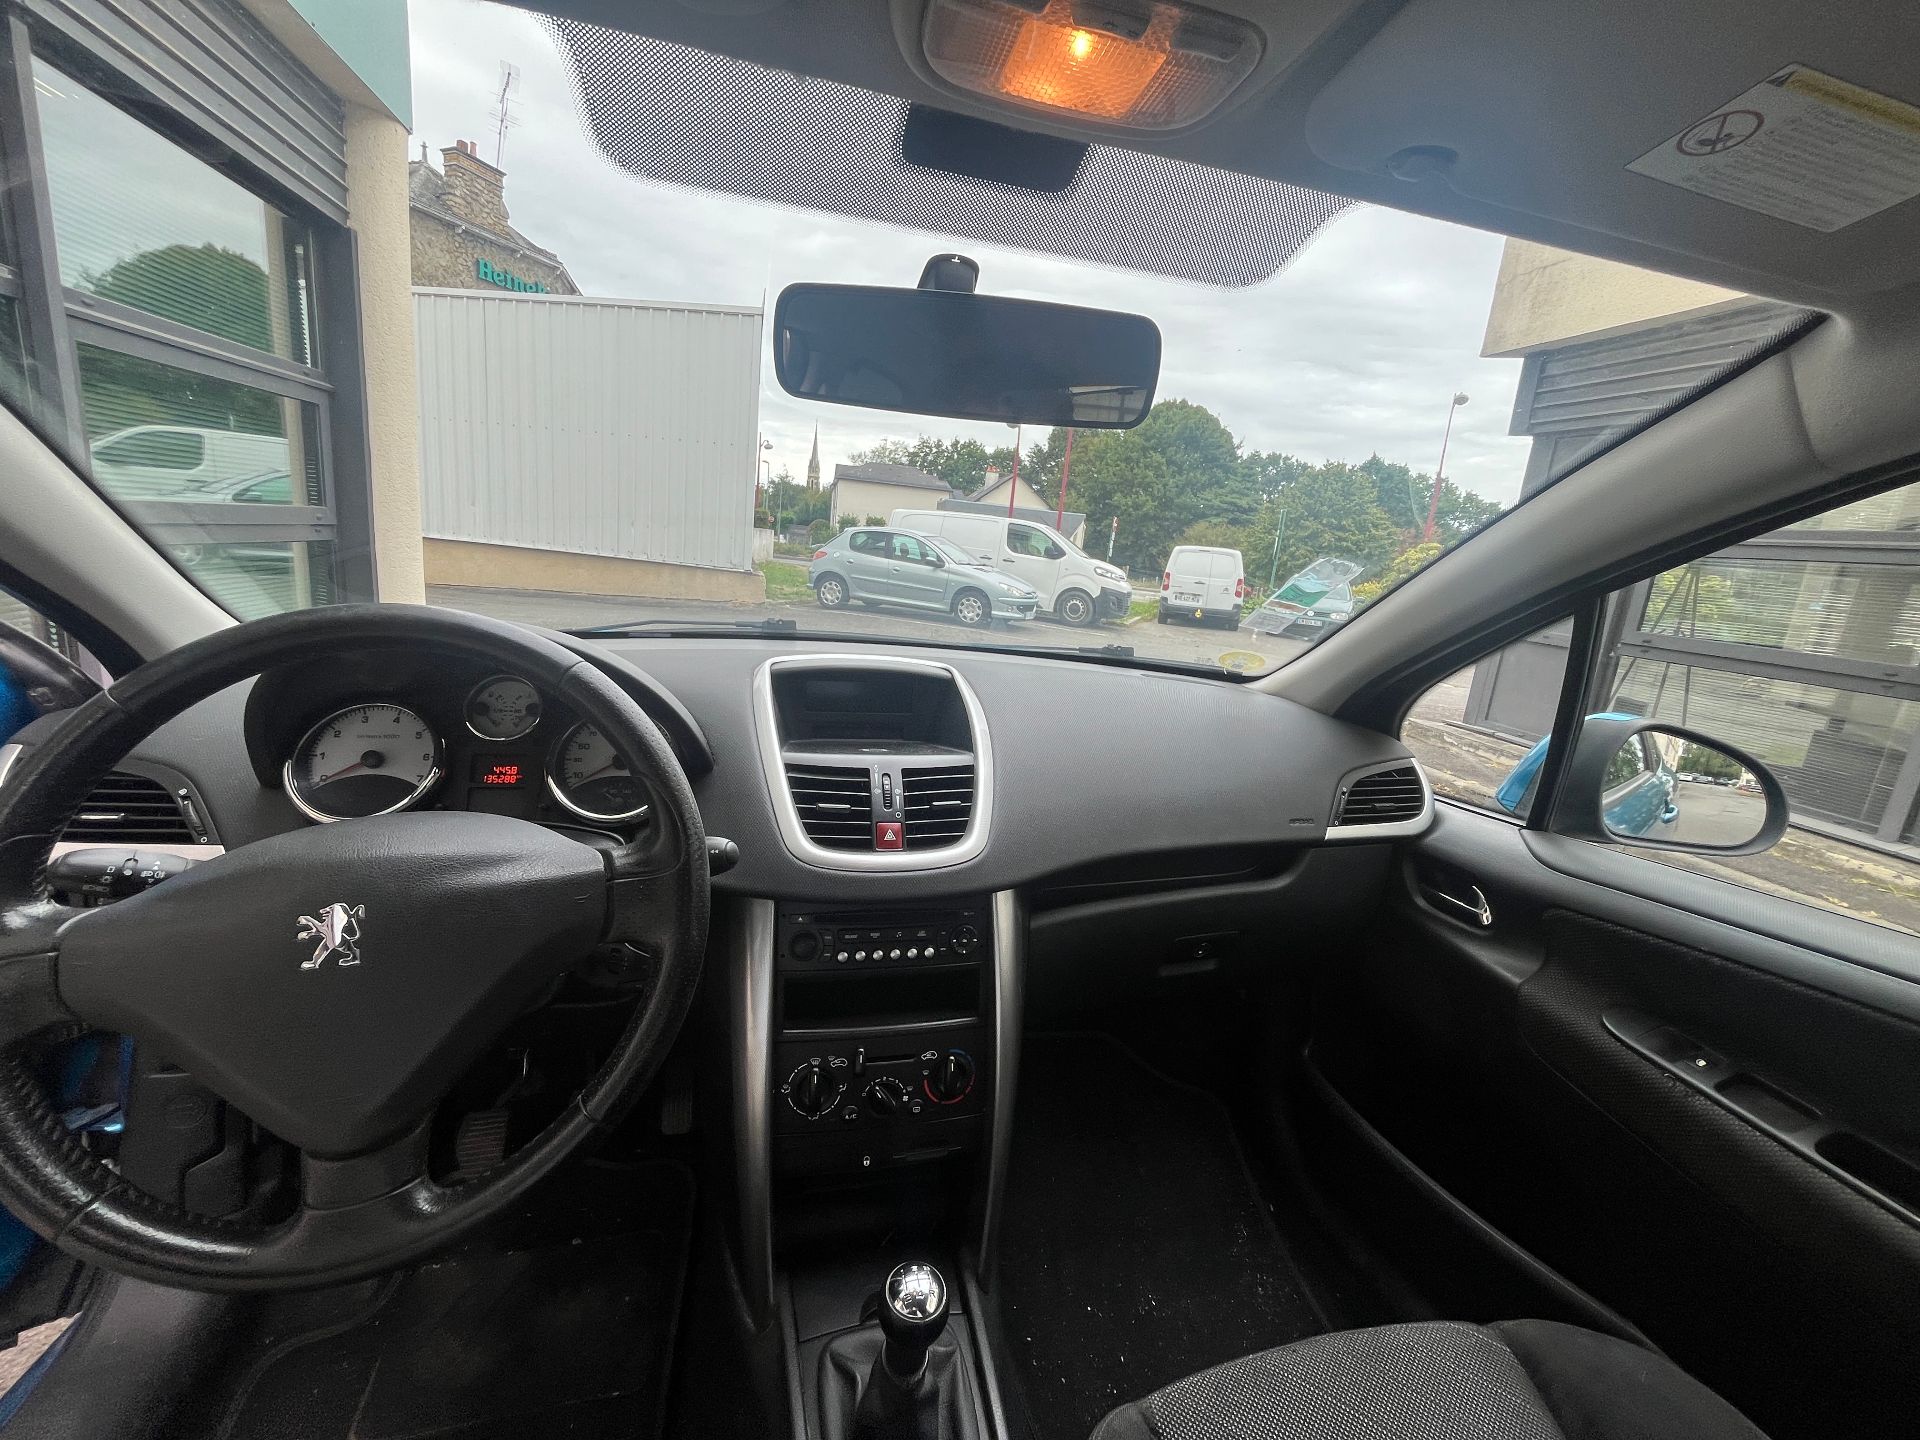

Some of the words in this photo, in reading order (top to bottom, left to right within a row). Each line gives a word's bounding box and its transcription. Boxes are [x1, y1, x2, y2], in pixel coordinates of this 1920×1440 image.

[361, 715, 369, 724] 3
[392, 715, 401, 724] 4
[334, 730, 342, 738] 2
[415, 731, 423, 740] 5
[319, 752, 326, 760] 1
[423, 753, 431, 761] 6
[573, 771, 584, 779] 10
[483, 775, 517, 784] 135288
